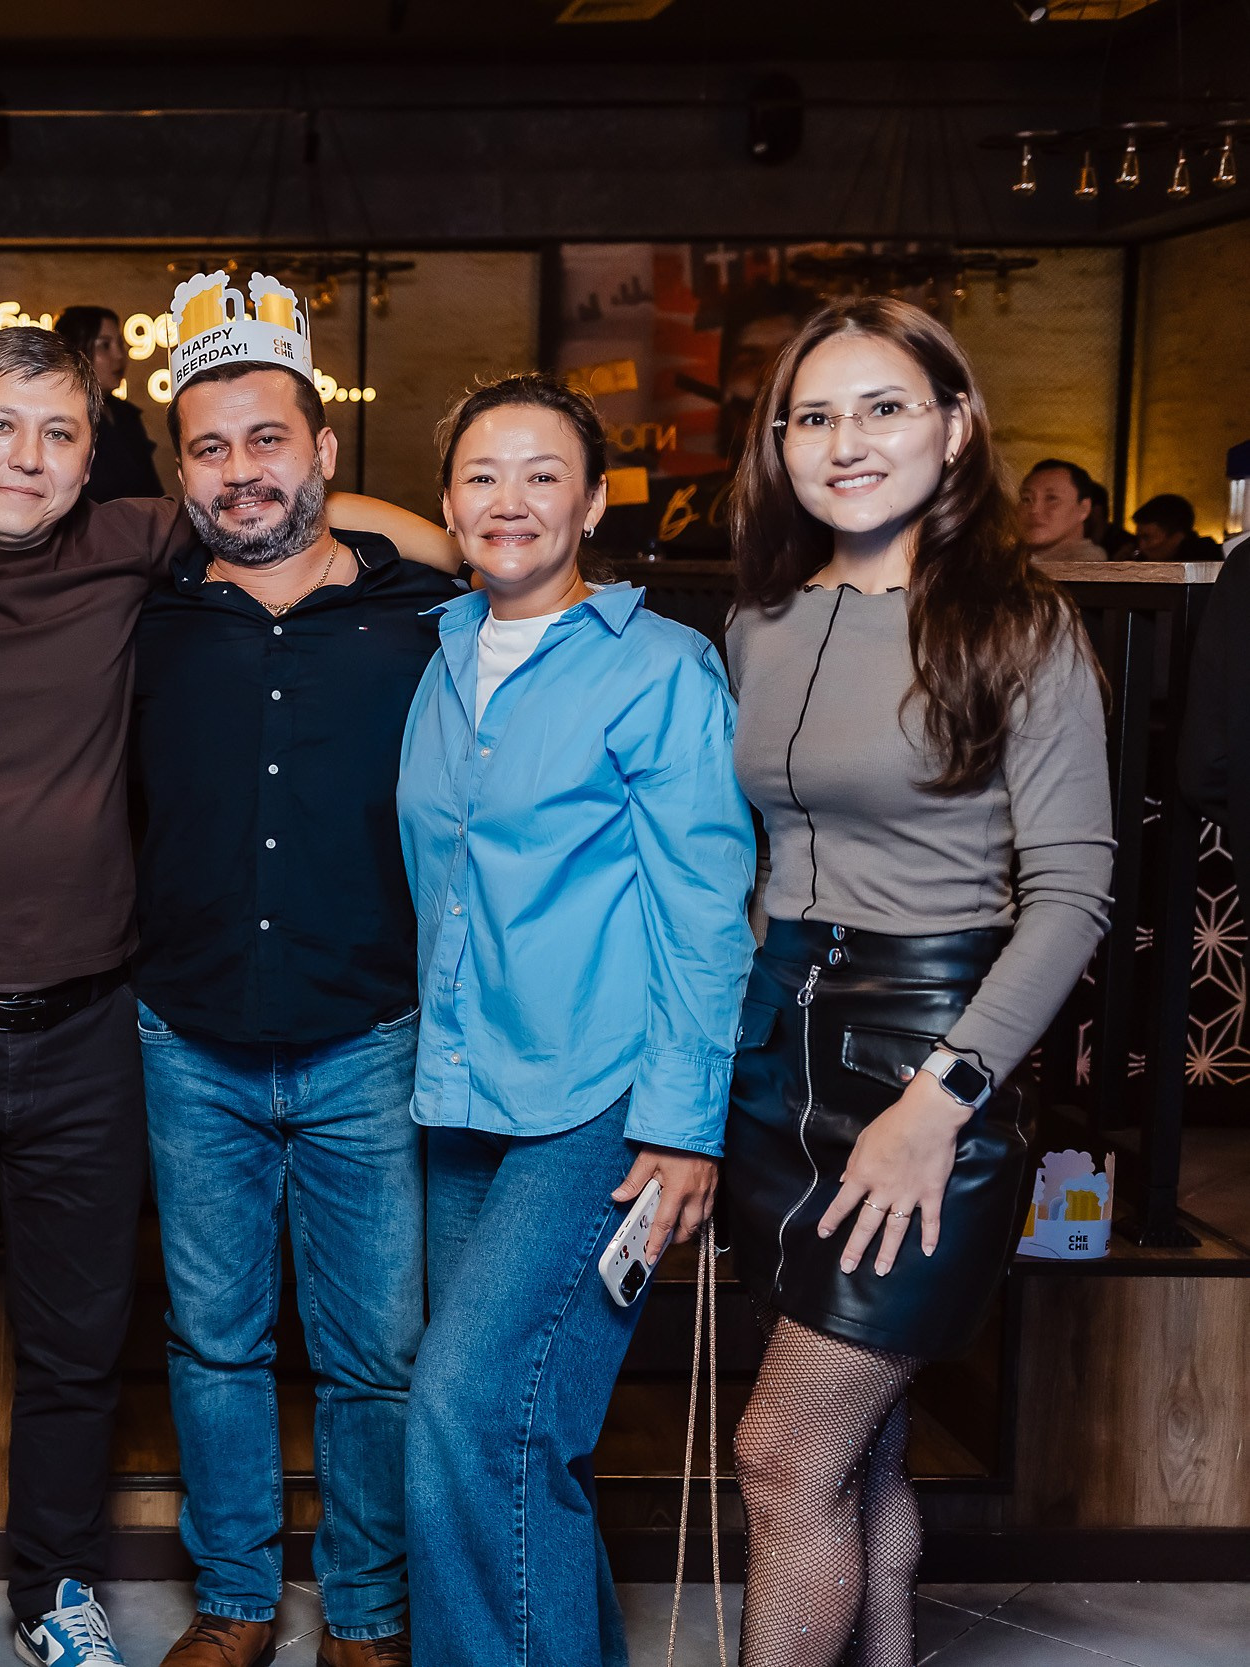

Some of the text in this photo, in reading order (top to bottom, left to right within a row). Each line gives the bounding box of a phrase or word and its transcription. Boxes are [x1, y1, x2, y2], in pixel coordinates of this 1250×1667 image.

[181, 327, 233, 361] HAPPY
[273, 338, 292, 351] CHE
[274, 346, 294, 360] CHIL
[176, 342, 248, 384] BEERDAY!
[1068, 1235, 1088, 1243] CHE
